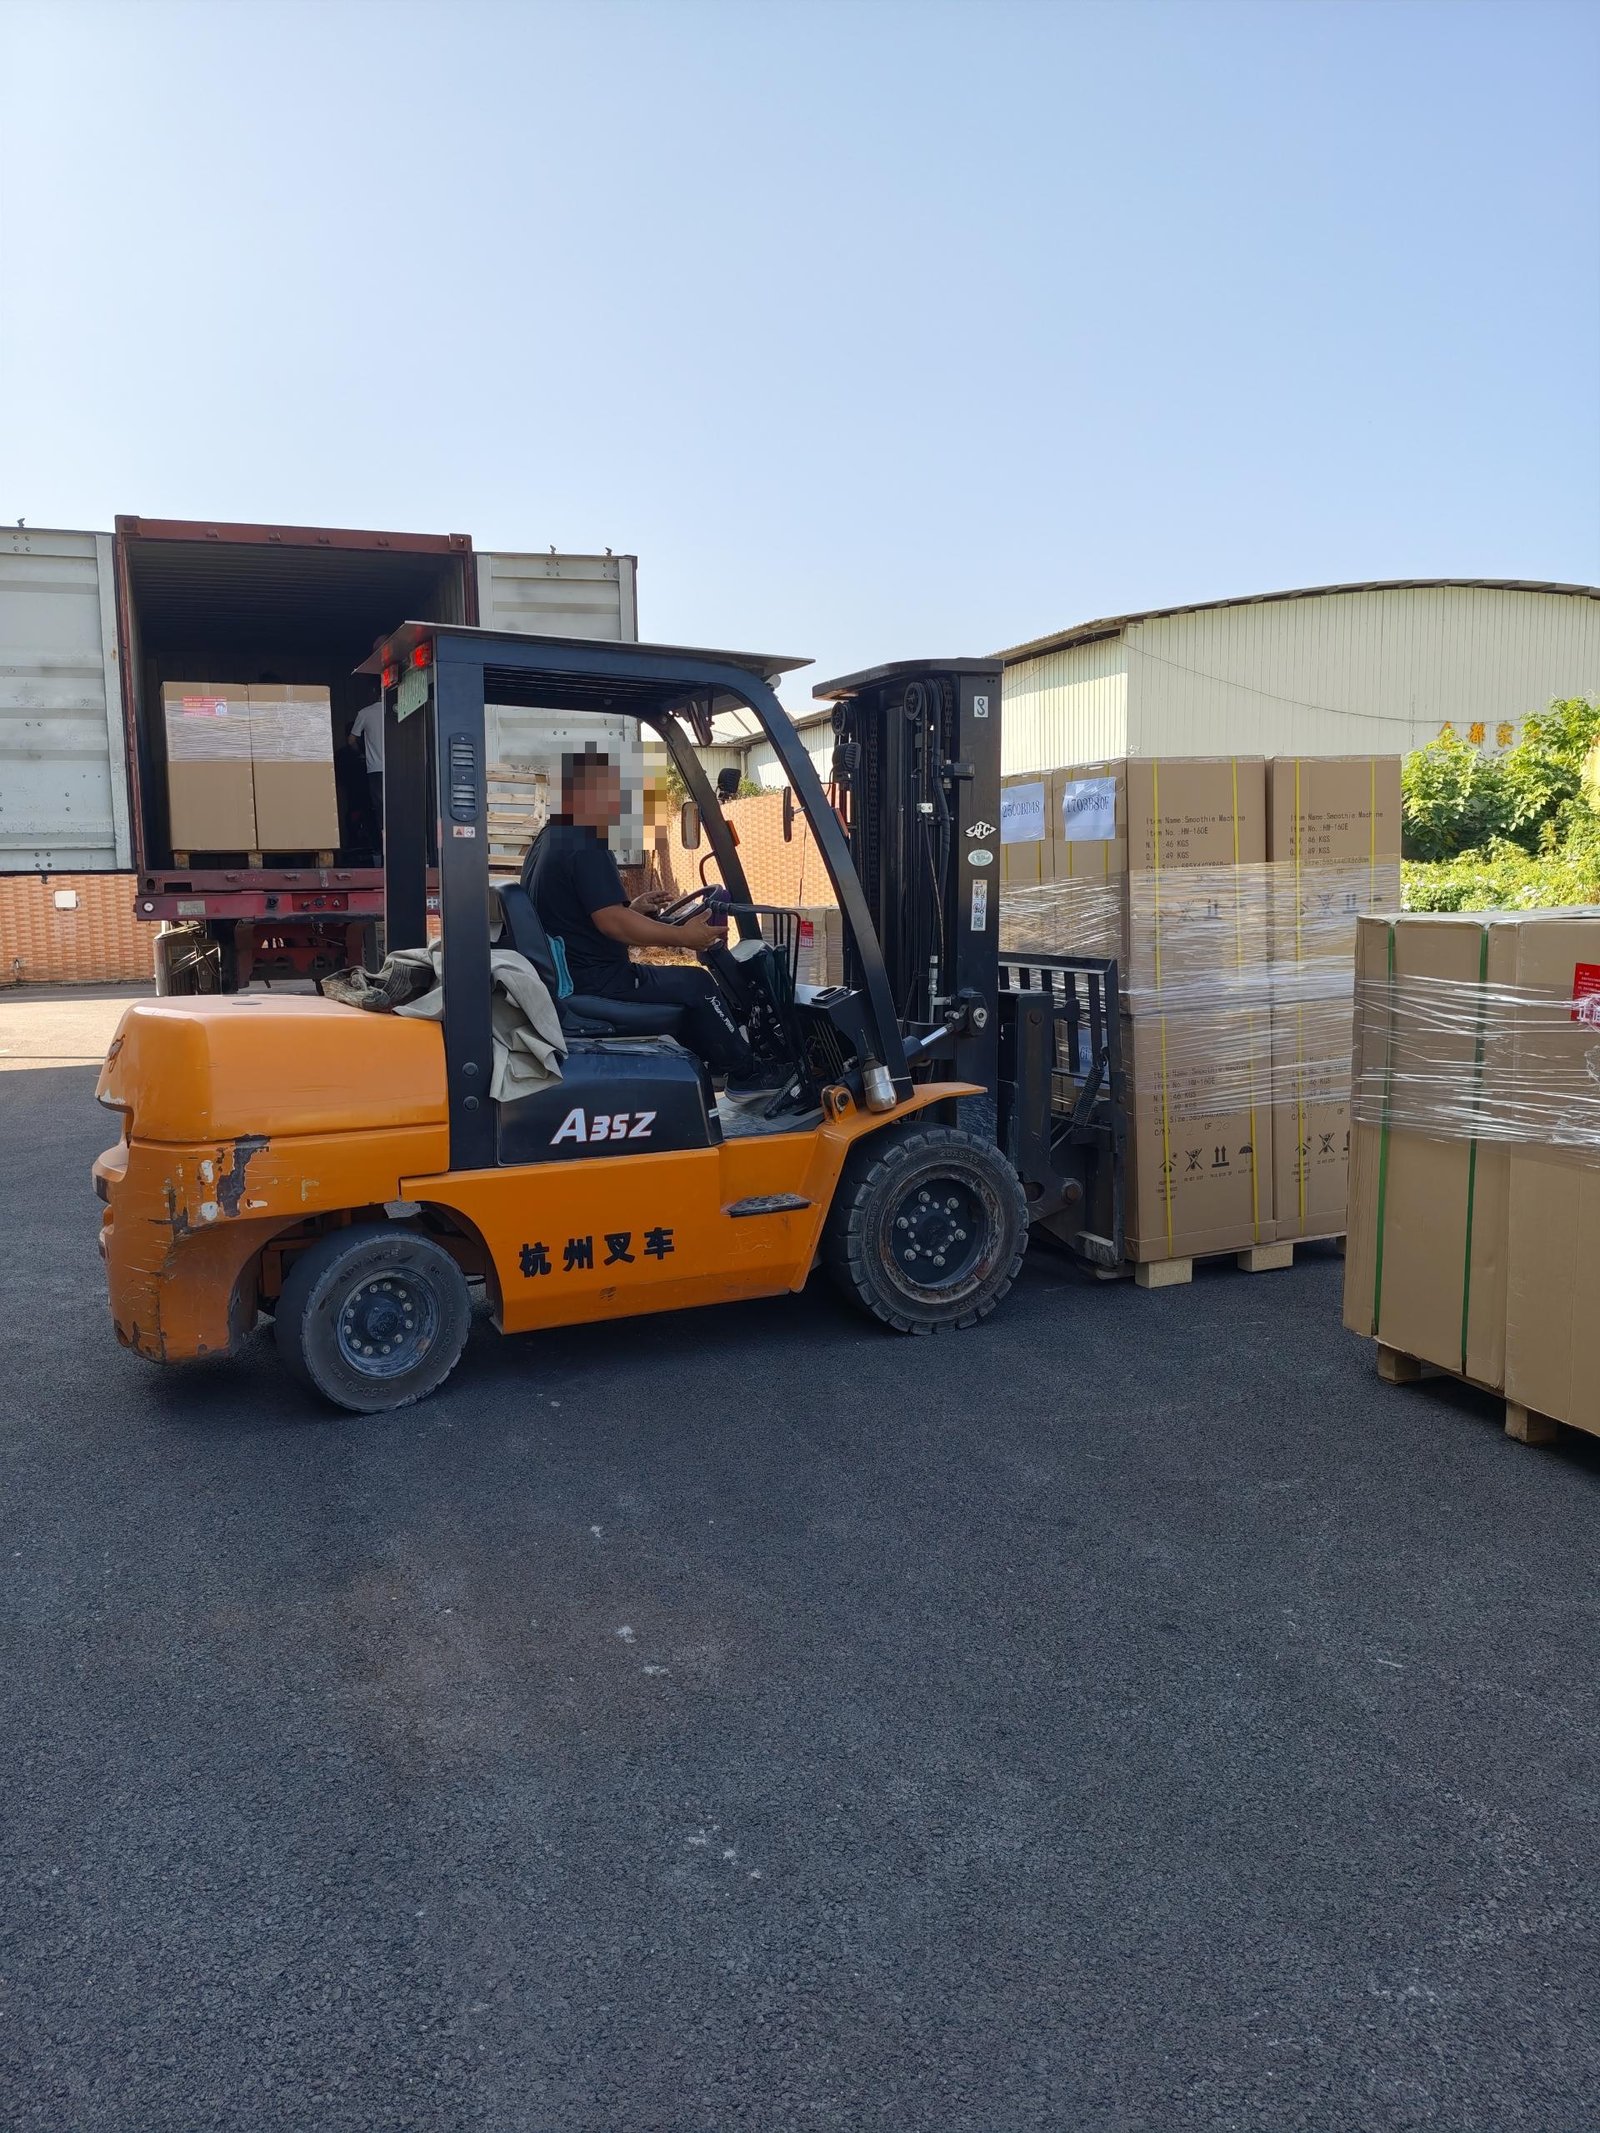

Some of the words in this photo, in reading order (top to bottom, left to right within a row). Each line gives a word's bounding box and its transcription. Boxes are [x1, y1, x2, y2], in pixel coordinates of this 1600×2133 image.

[1219, 814, 1246, 823] Machne
[1359, 810, 1384, 819] Machne
[519, 1227, 674, 1278] 杭州叉车
